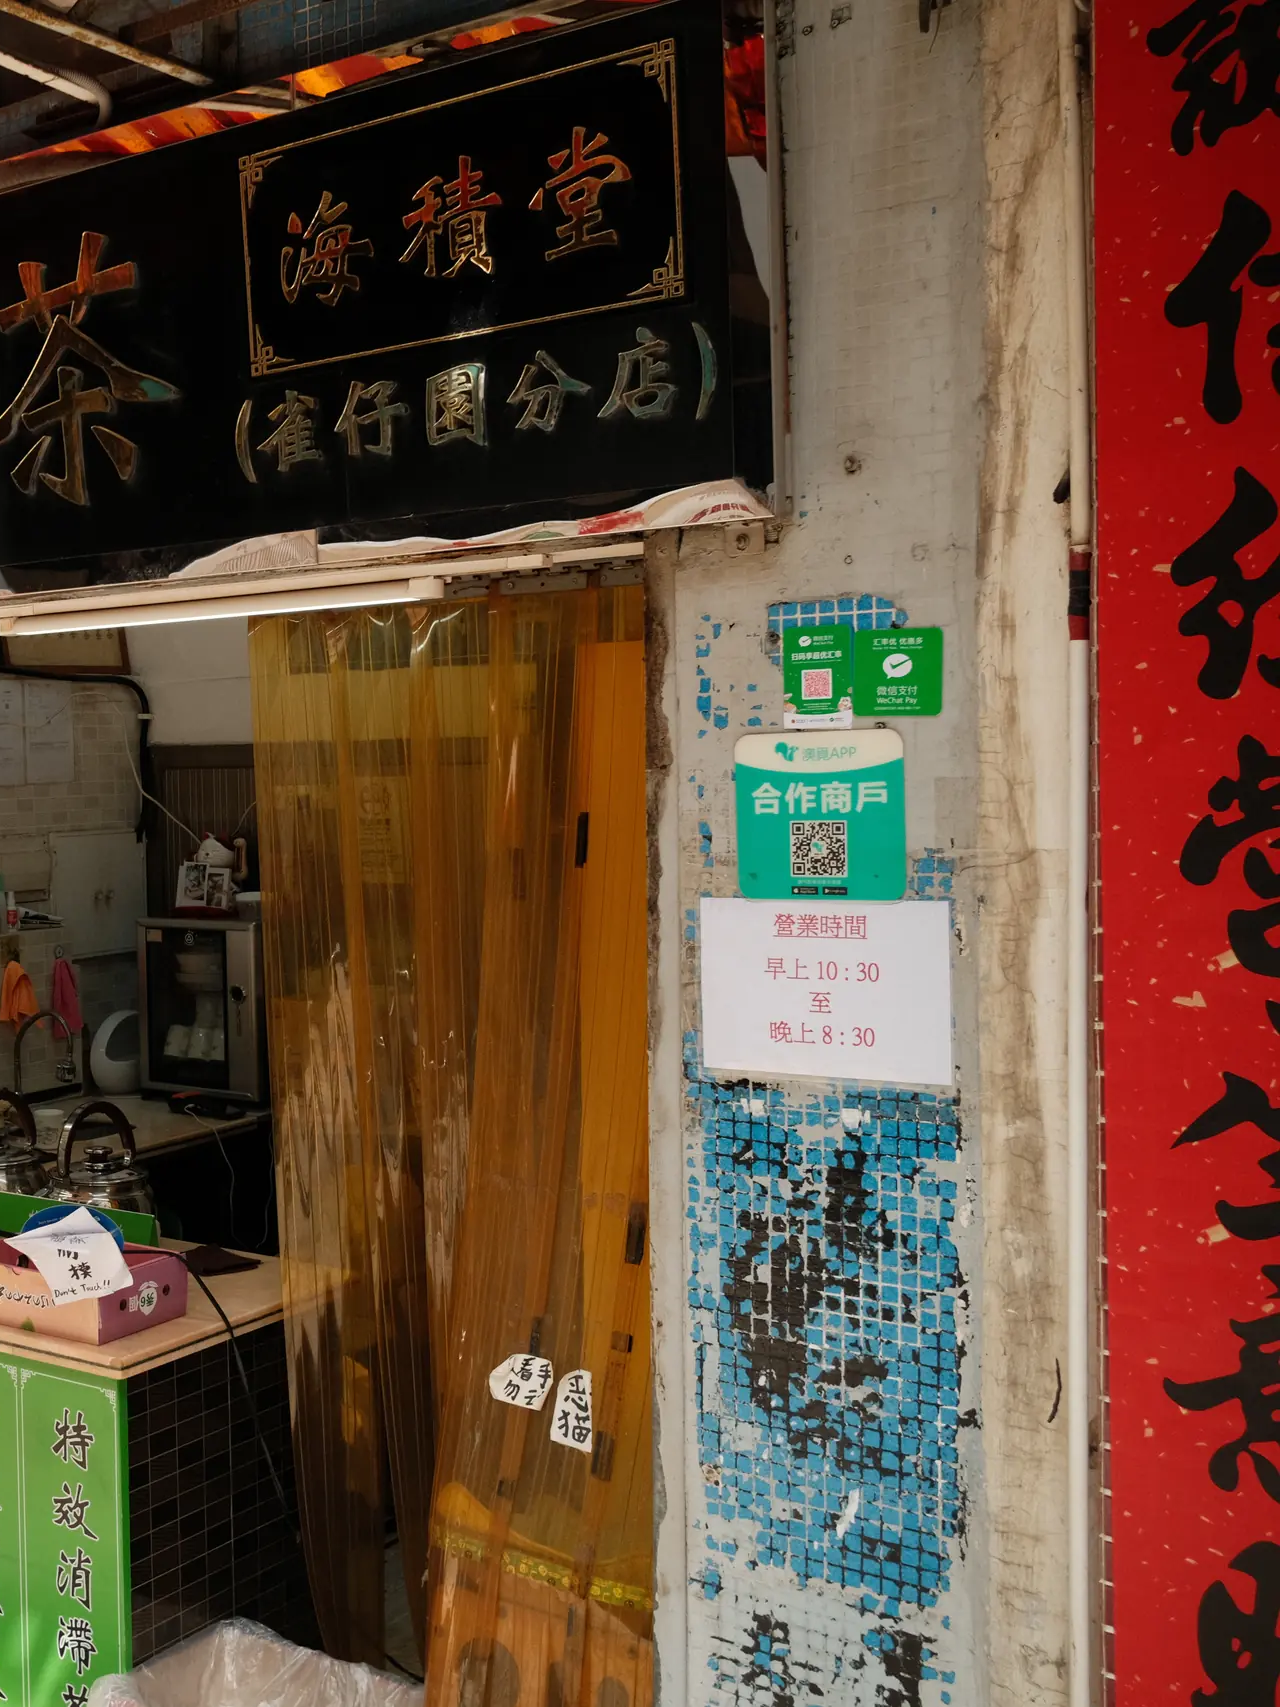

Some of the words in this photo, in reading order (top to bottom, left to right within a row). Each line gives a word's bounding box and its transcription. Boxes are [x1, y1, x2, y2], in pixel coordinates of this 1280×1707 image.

[280, 126, 633, 307] 海積堂
[876, 685, 918, 696] 微信支付
[905, 697, 918, 705] Pay
[773, 912, 868, 938] 營業時間
[809, 991, 833, 1014] 至
[54, 1288, 78, 1298] Don't
